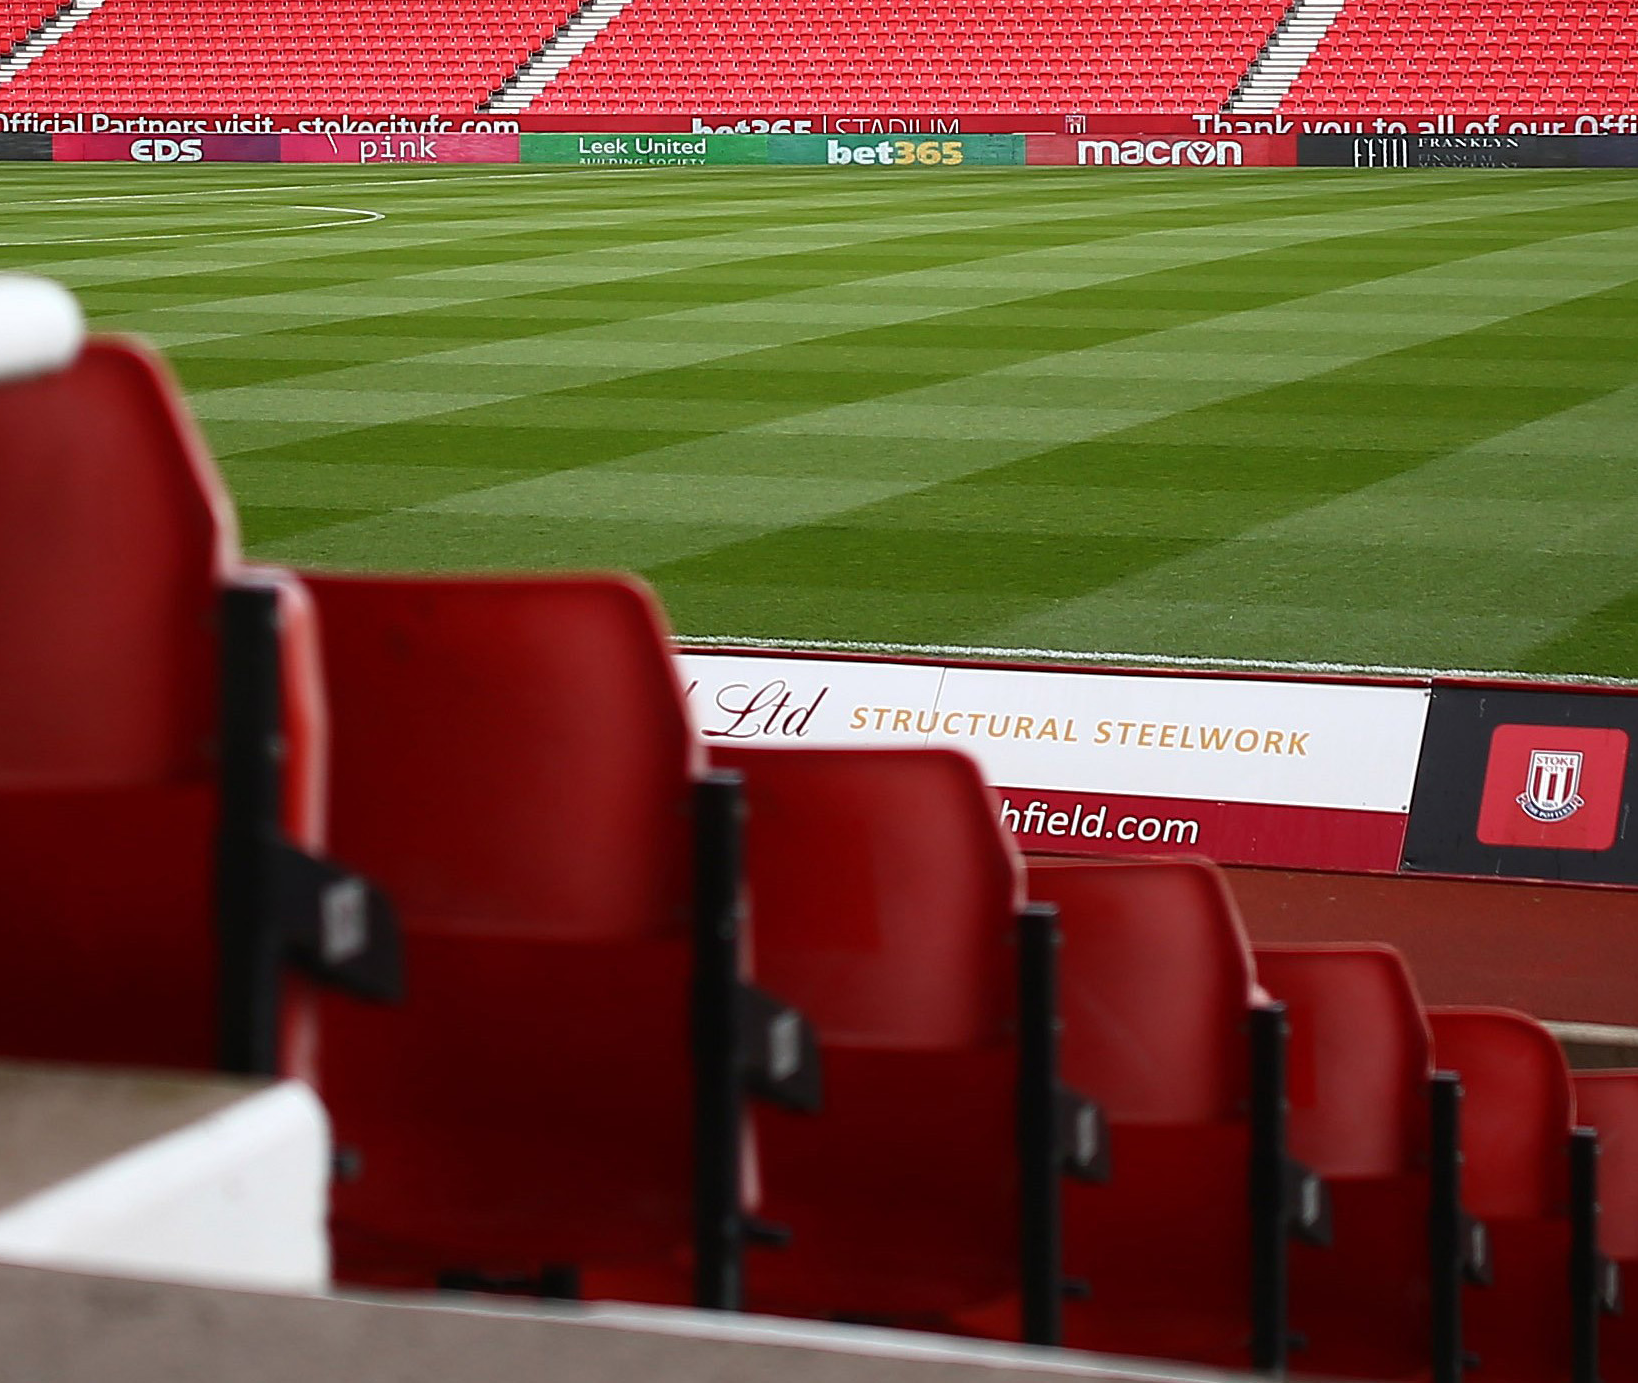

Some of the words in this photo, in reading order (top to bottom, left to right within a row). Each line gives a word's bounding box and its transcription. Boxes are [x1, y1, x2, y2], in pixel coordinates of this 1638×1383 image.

[130, 138, 203, 163] EDS
[360, 135, 438, 164] pink
[578, 137, 628, 155] Leek
[635, 137, 707, 155] United
[826, 139, 964, 166] bet365
[1077, 140, 1242, 166] macron
[1418, 137, 1520, 149] FRANKLYN
[703, 679, 830, 740] Ltd
[849, 705, 1078, 745] STRUCTURAL
[1093, 719, 1311, 758] STEELWORK
[1536, 755, 1576, 767] STOKE
[999, 800, 1199, 845] hfield.com
